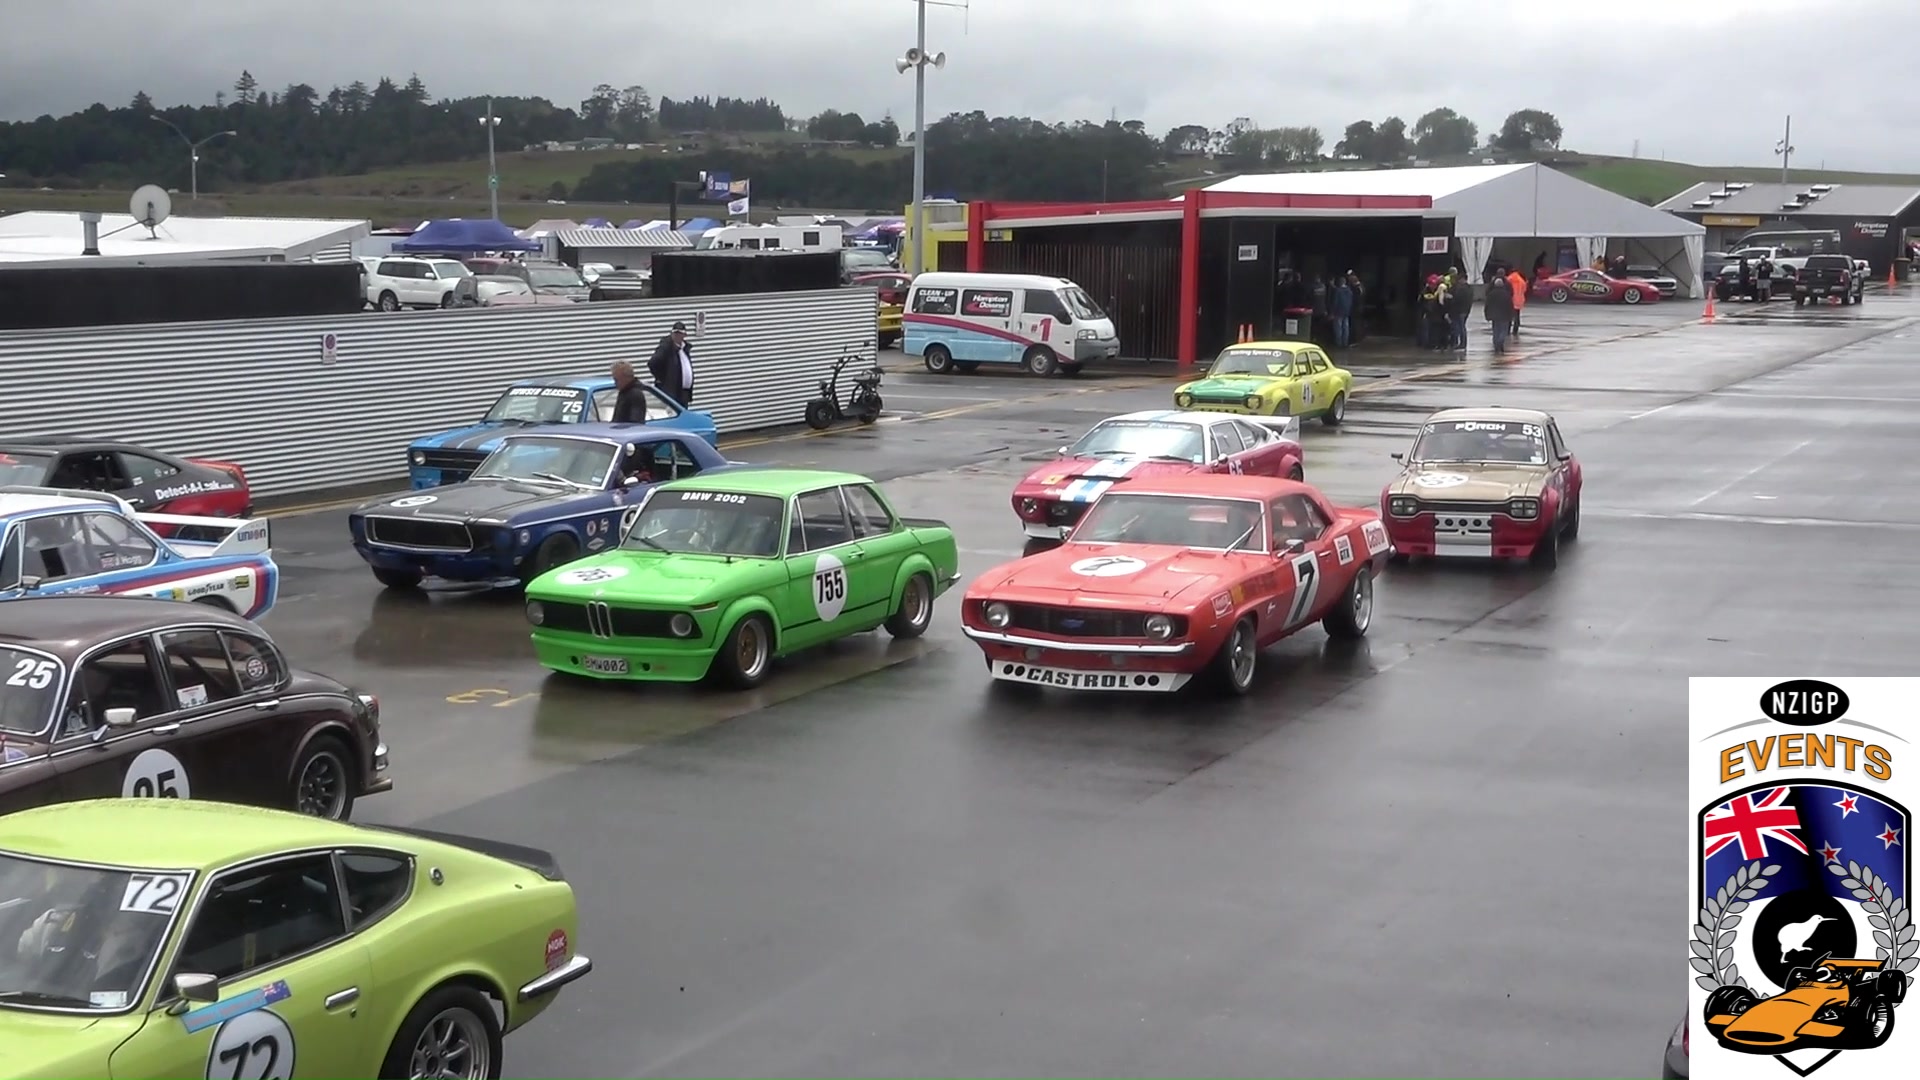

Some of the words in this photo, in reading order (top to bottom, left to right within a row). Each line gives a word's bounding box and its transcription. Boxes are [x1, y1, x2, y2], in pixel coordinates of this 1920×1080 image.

[973, 295, 1008, 303] Hampton
[562, 401, 583, 413] 75
[1522, 424, 1542, 438] 53
[682, 492, 711, 501] BMW
[714, 493, 747, 504] 2002
[816, 570, 844, 604] 755
[1290, 560, 1315, 624] 7
[6, 658, 57, 690] 25
[1027, 666, 1129, 688] CASTROL
[127, 876, 179, 912] 72
[219, 1035, 278, 1080] 72
